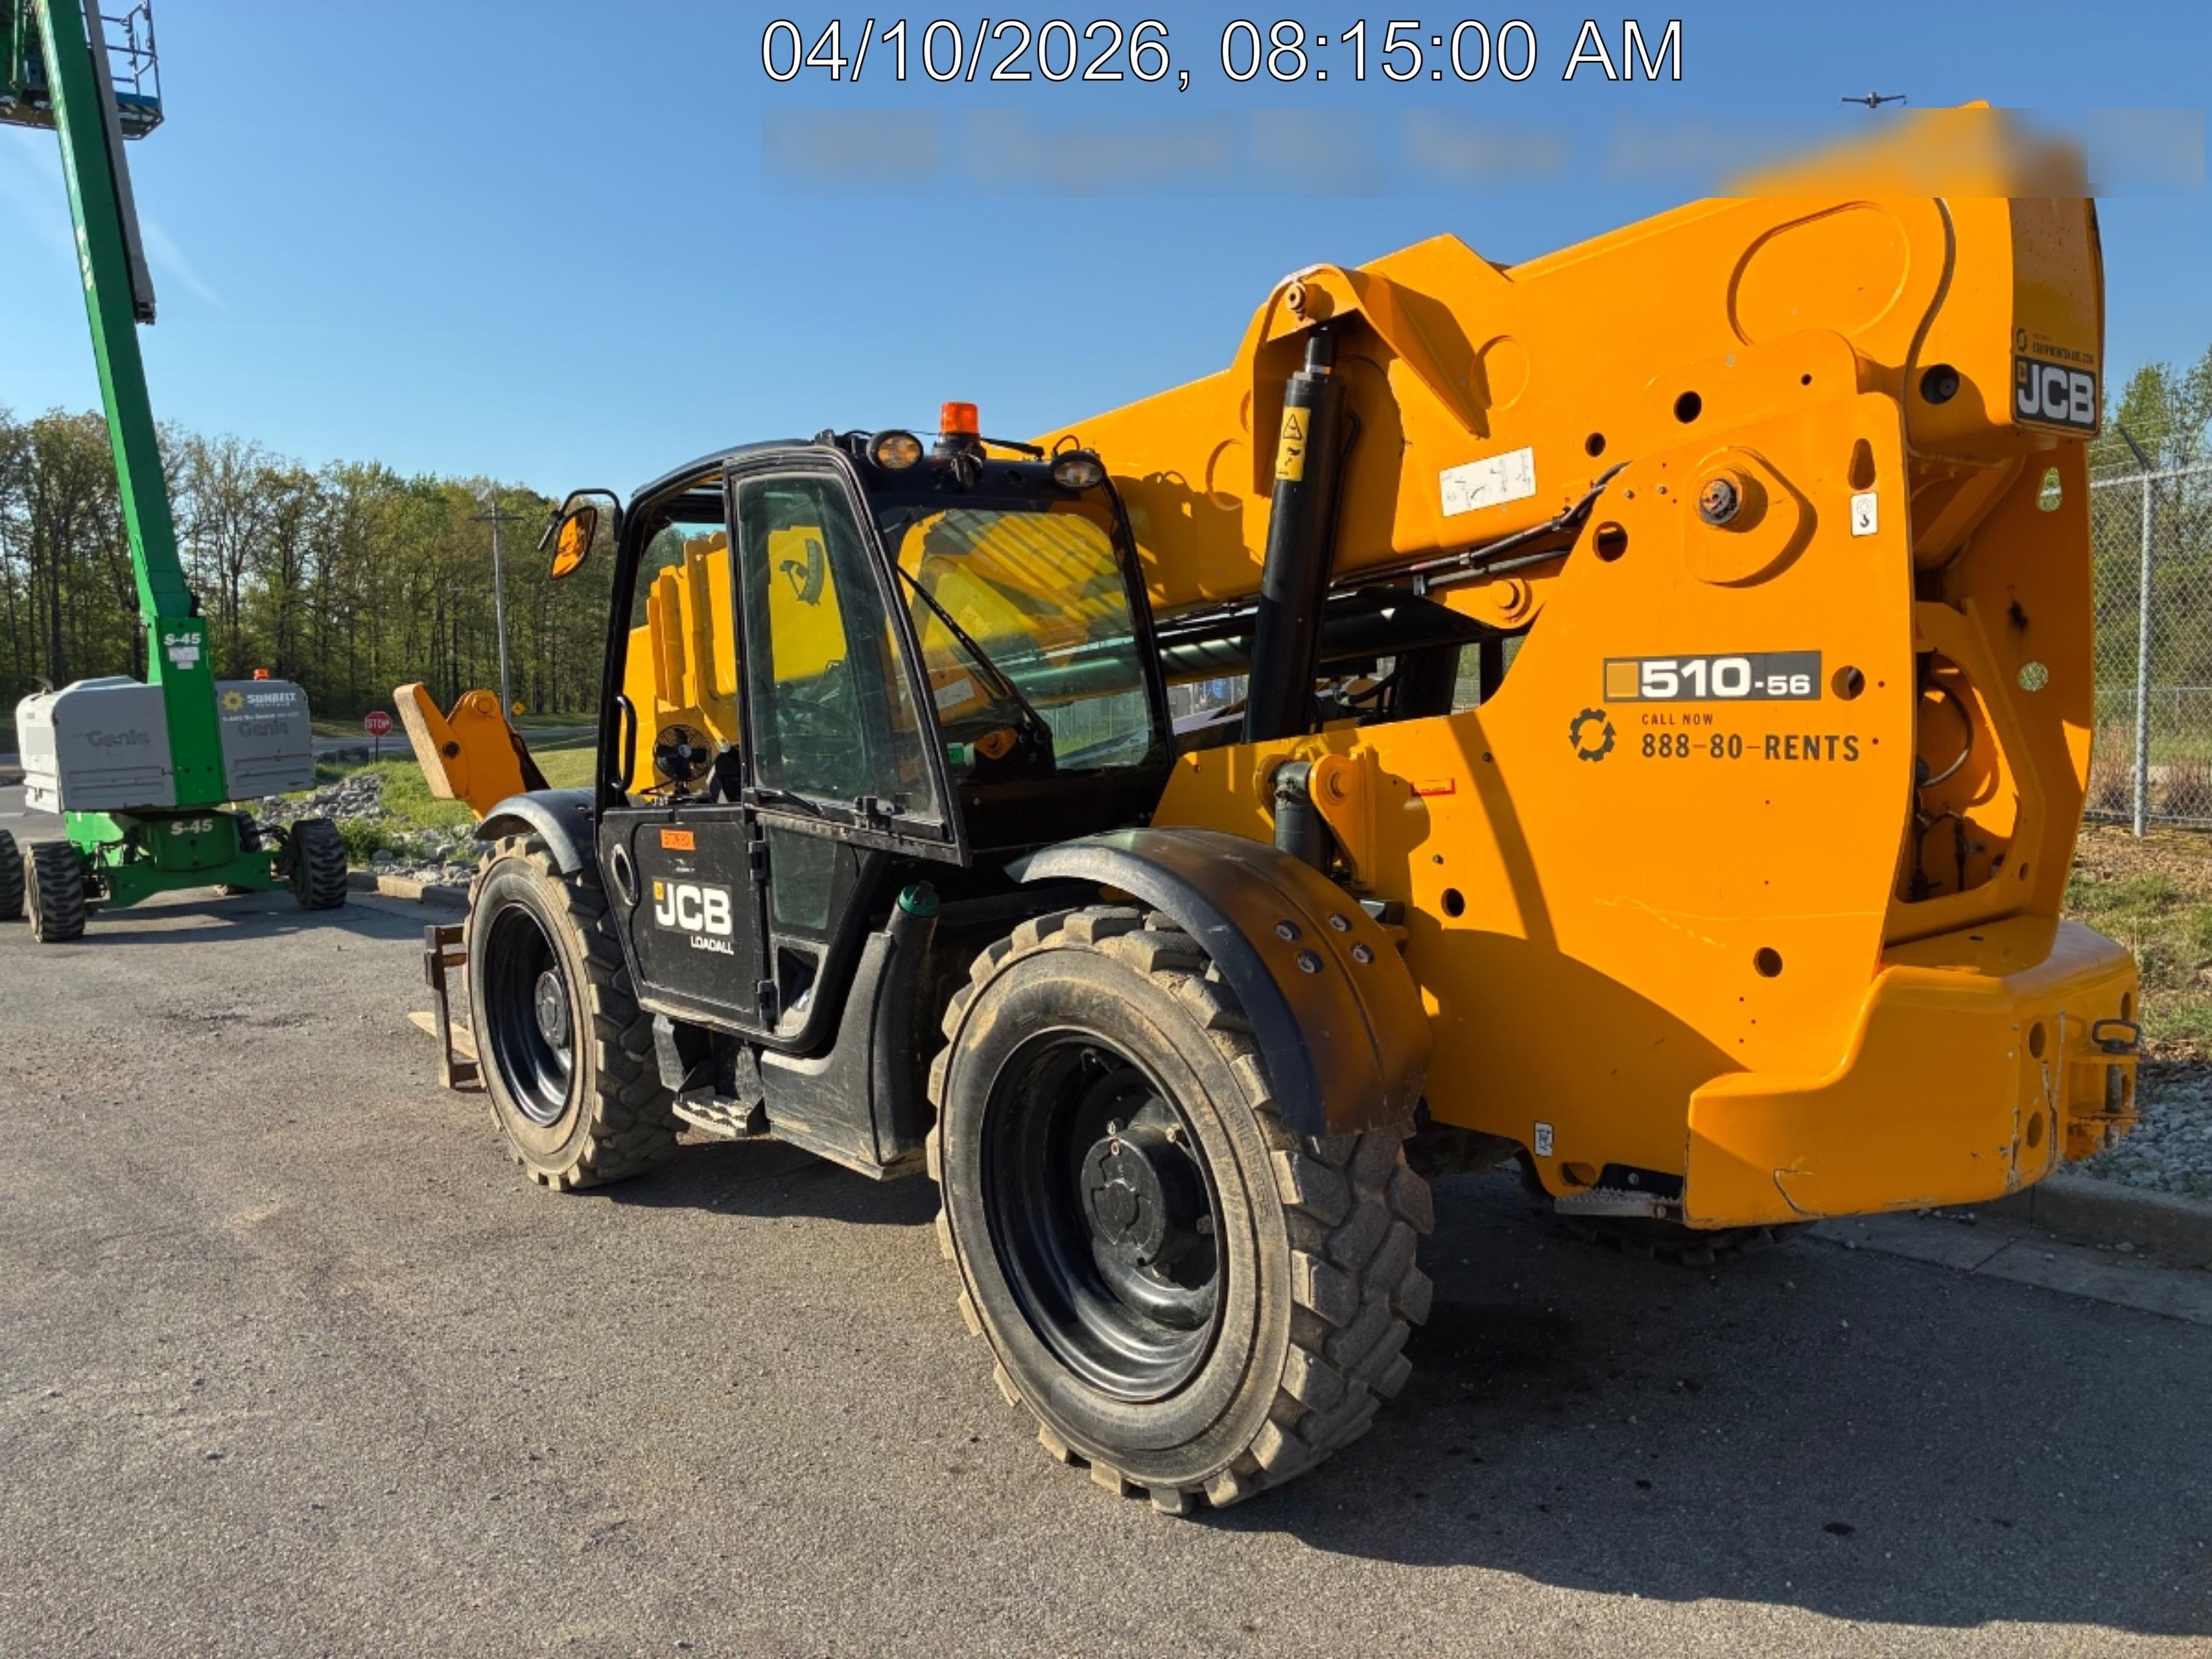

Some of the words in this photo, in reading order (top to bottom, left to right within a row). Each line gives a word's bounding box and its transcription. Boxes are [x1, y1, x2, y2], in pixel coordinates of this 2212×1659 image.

[2018, 364, 2095, 424] JCB
[163, 632, 202, 646] S-45
[1642, 658, 1811, 697] 510-56
[367, 718, 390, 729] STOP
[1642, 713, 1676, 726] CALL
[1682, 713, 1714, 725] NOW
[87, 729, 150, 748] Genie
[1642, 733, 1859, 761] 888-80-RENTS
[171, 818, 213, 836] S-45
[655, 882, 732, 935] JCB
[691, 935, 734, 955] LOADALL
